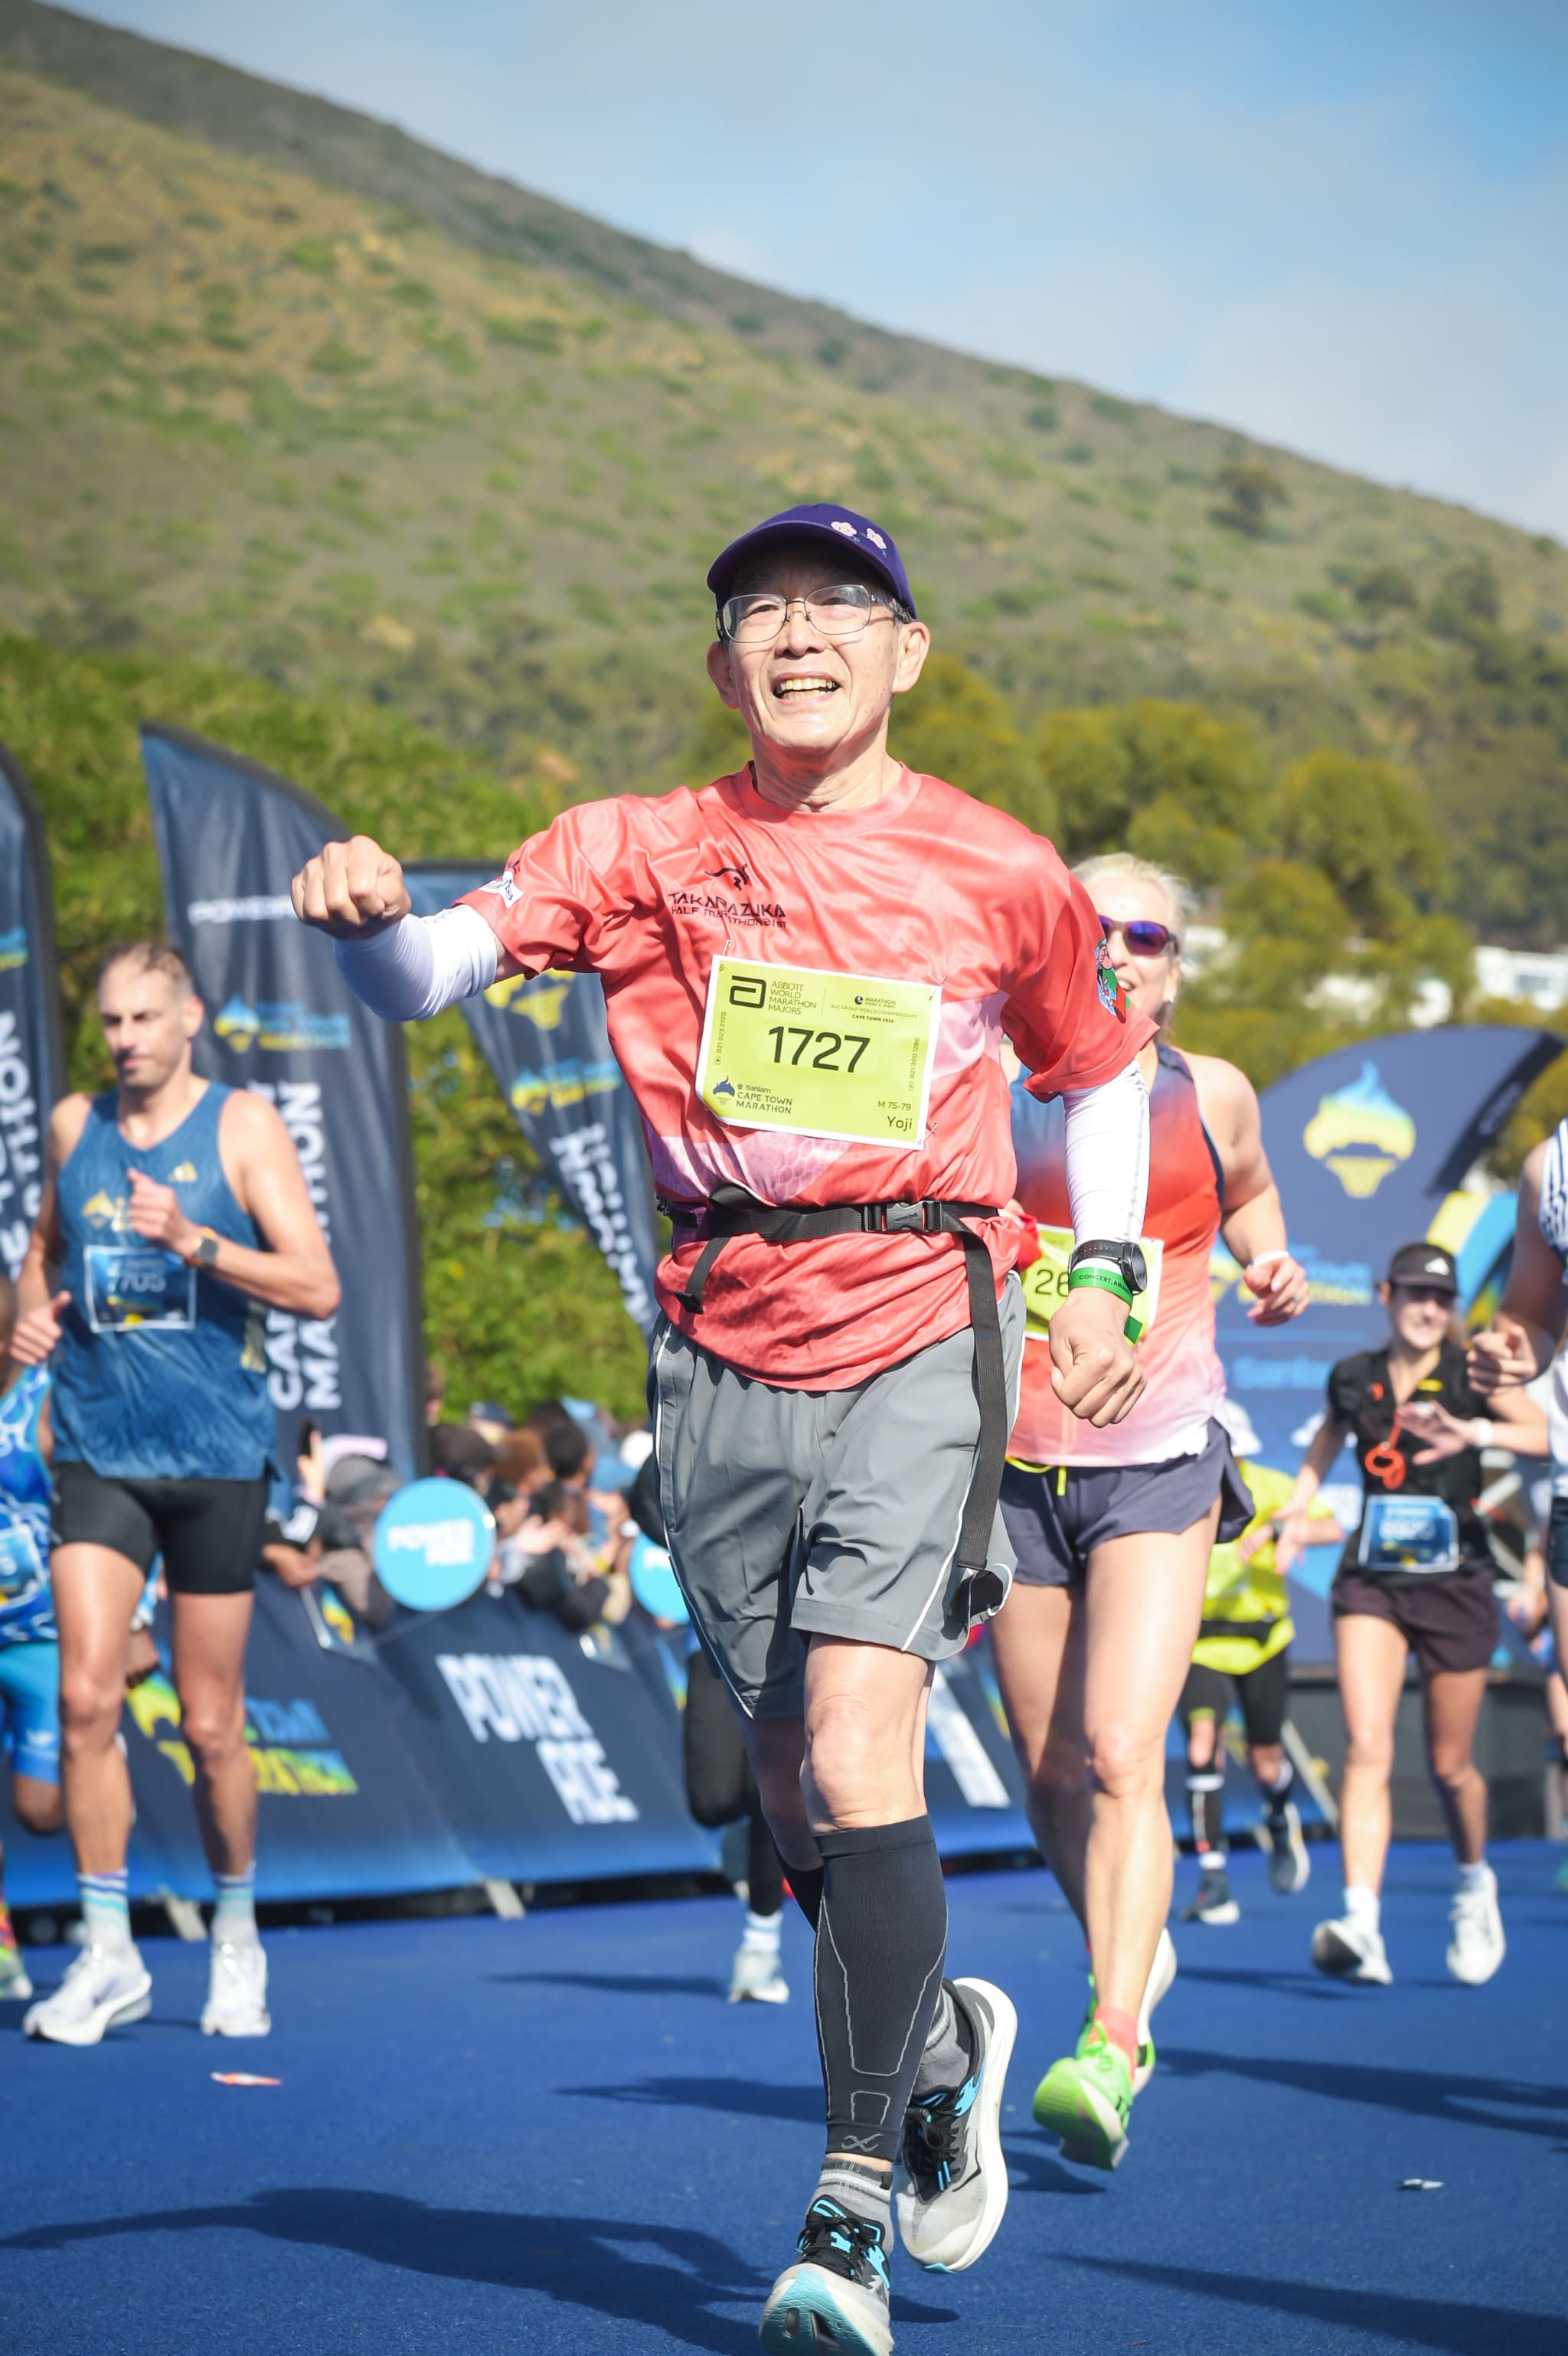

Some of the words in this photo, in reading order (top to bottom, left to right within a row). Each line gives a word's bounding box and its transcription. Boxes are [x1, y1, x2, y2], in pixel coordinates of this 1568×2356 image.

[671, 906, 700, 915] HALF
[771, 981, 804, 992] ABBOTT
[770, 988, 802, 999] WORLD
[769, 996, 817, 1008] MARATHON
[768, 1004, 802, 1015] MAJORS
[768, 1026, 871, 1073] 1727
[745, 1084, 772, 1093] Sanlam
[737, 1092, 762, 1102] CAPE
[765, 1095, 792, 1106] TOWN
[736, 1100, 792, 1114] MARATHON
[887, 1101, 911, 1111] 75-79
[887, 1115, 913, 1132] Yoji
[1035, 1269, 1068, 1297] 26
